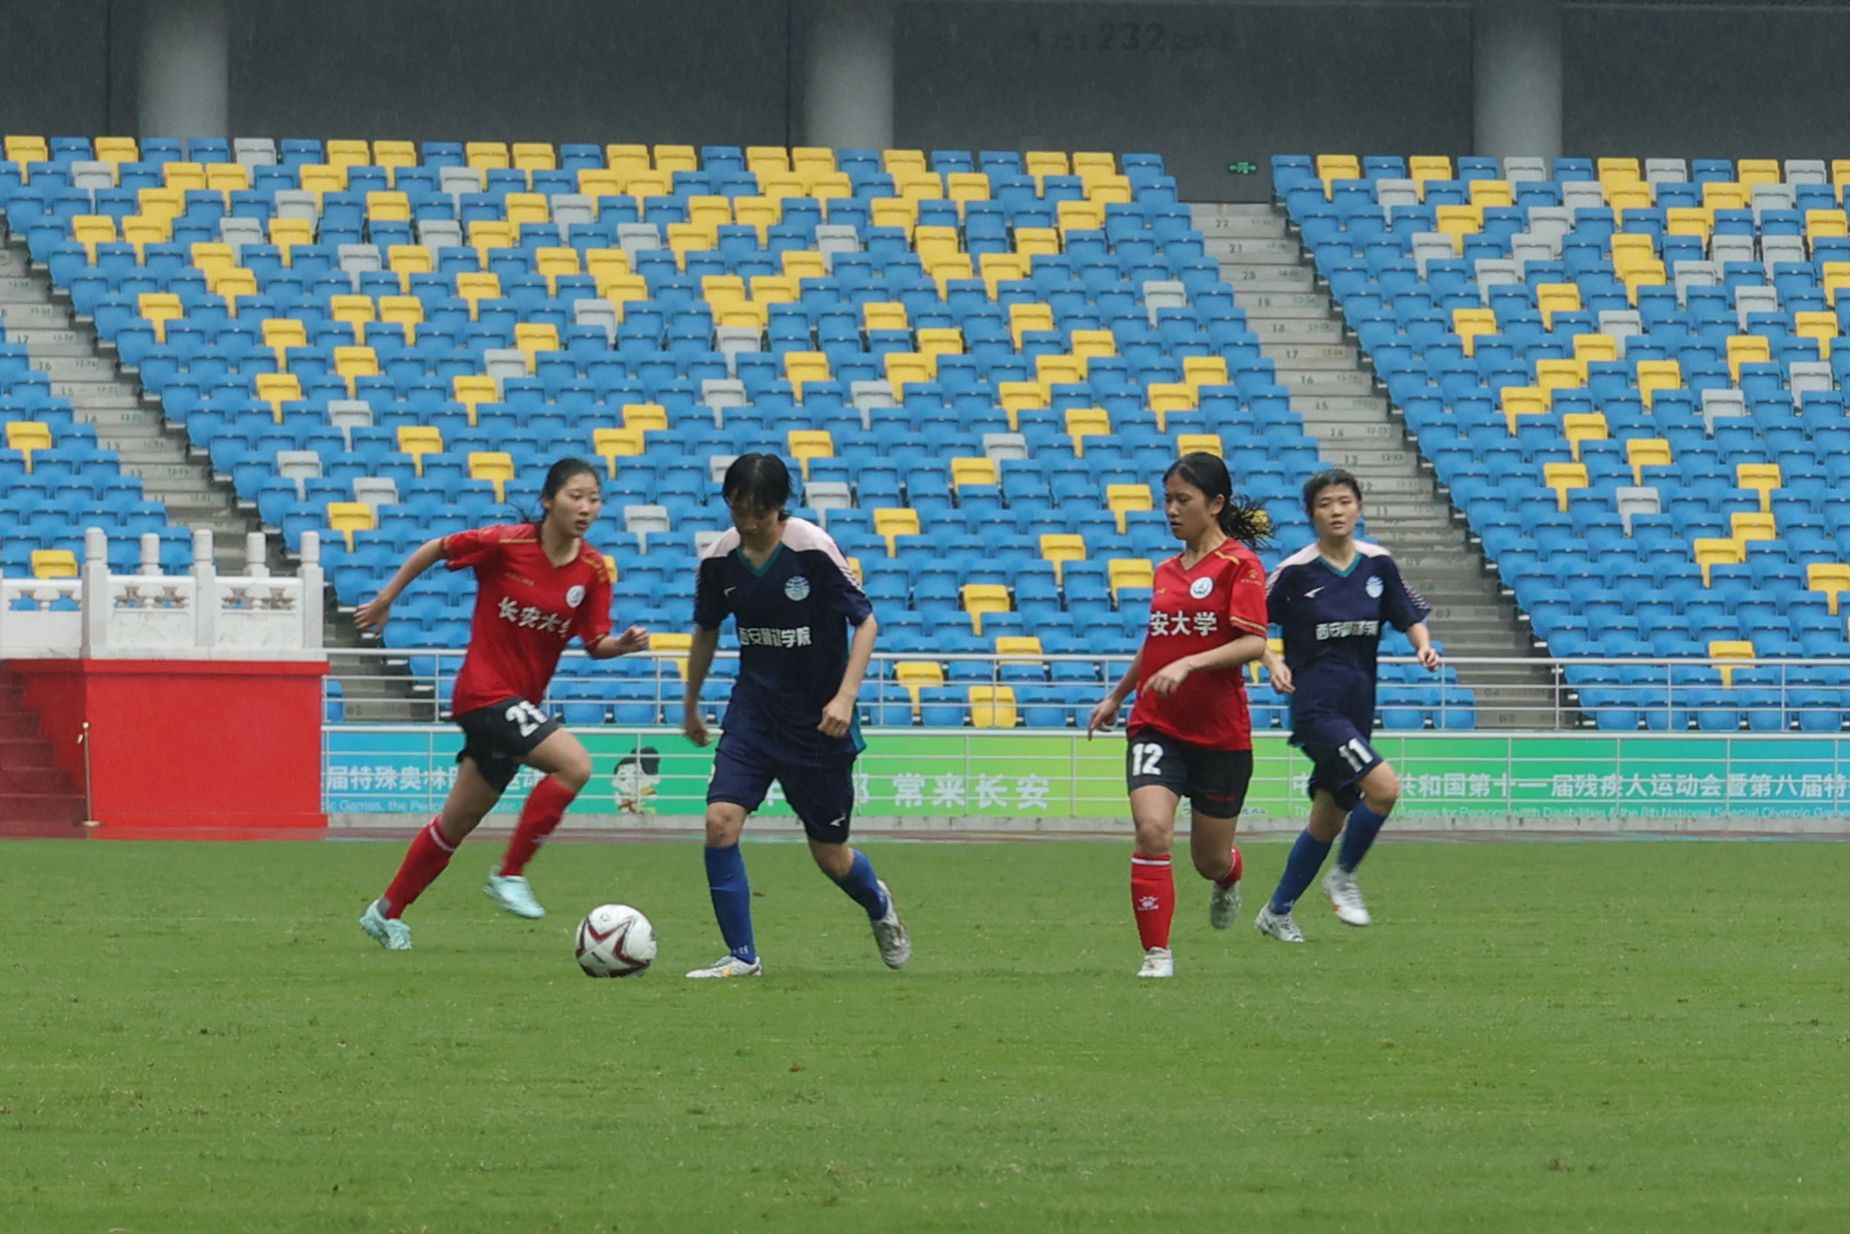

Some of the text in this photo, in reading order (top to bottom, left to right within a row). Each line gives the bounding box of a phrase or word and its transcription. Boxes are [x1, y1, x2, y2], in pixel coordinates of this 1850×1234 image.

[1095, 22, 1166, 50] 232
[1150, 610, 1218, 636] 安大学
[1132, 743, 1164, 777] 12
[1338, 737, 1373, 773] 11
[892, 773, 1050, 809] 常来长安
